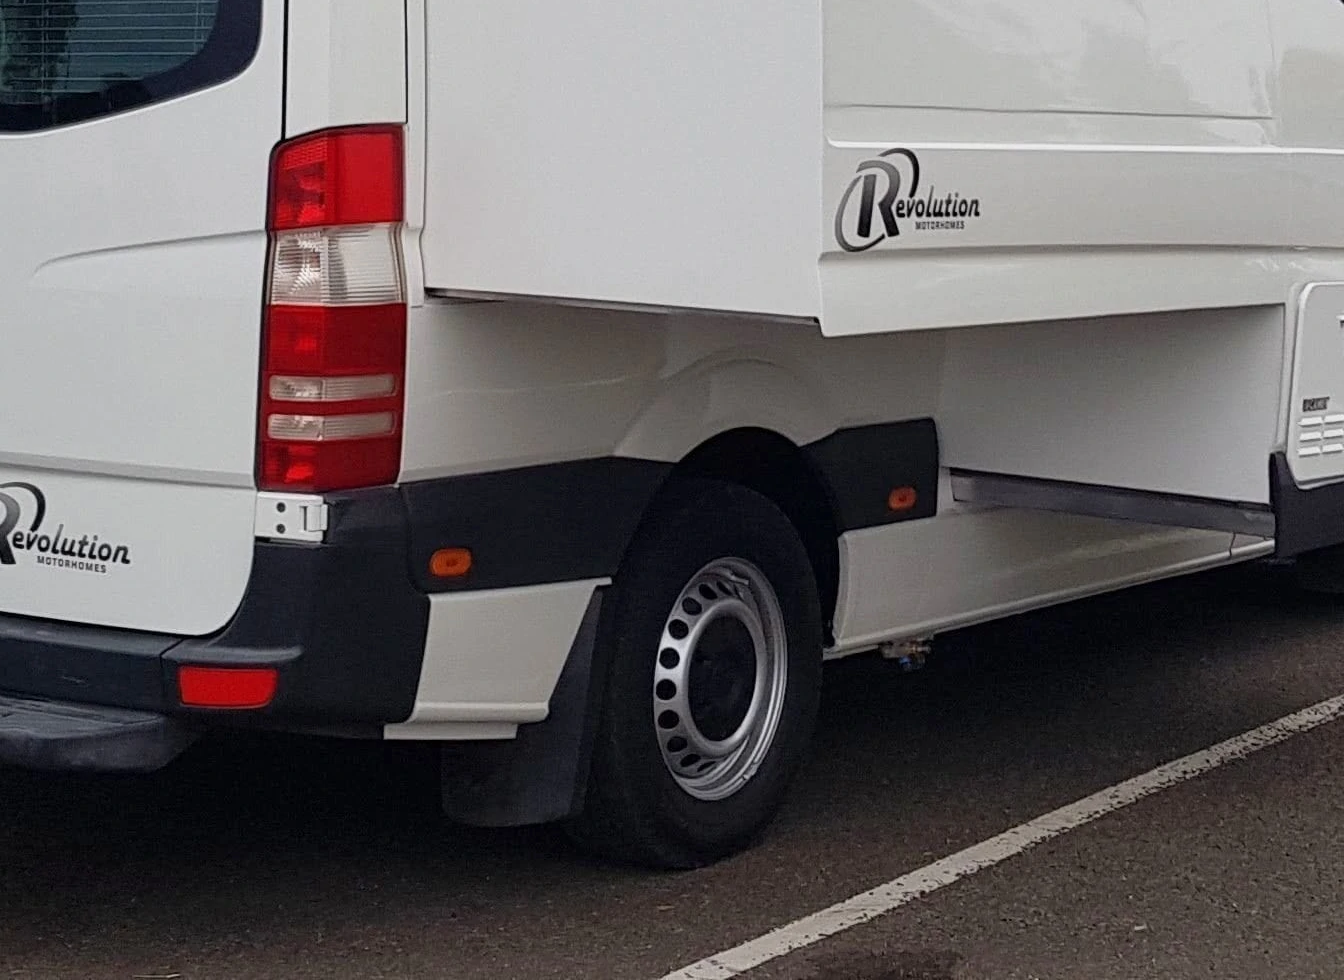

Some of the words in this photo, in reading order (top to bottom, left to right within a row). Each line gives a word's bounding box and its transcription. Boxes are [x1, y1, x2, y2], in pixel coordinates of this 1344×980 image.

[856, 159, 980, 238] Revolution
[914, 220, 965, 230] MOTORHOMES
[37, 555, 106, 574] MOTORHOMES
